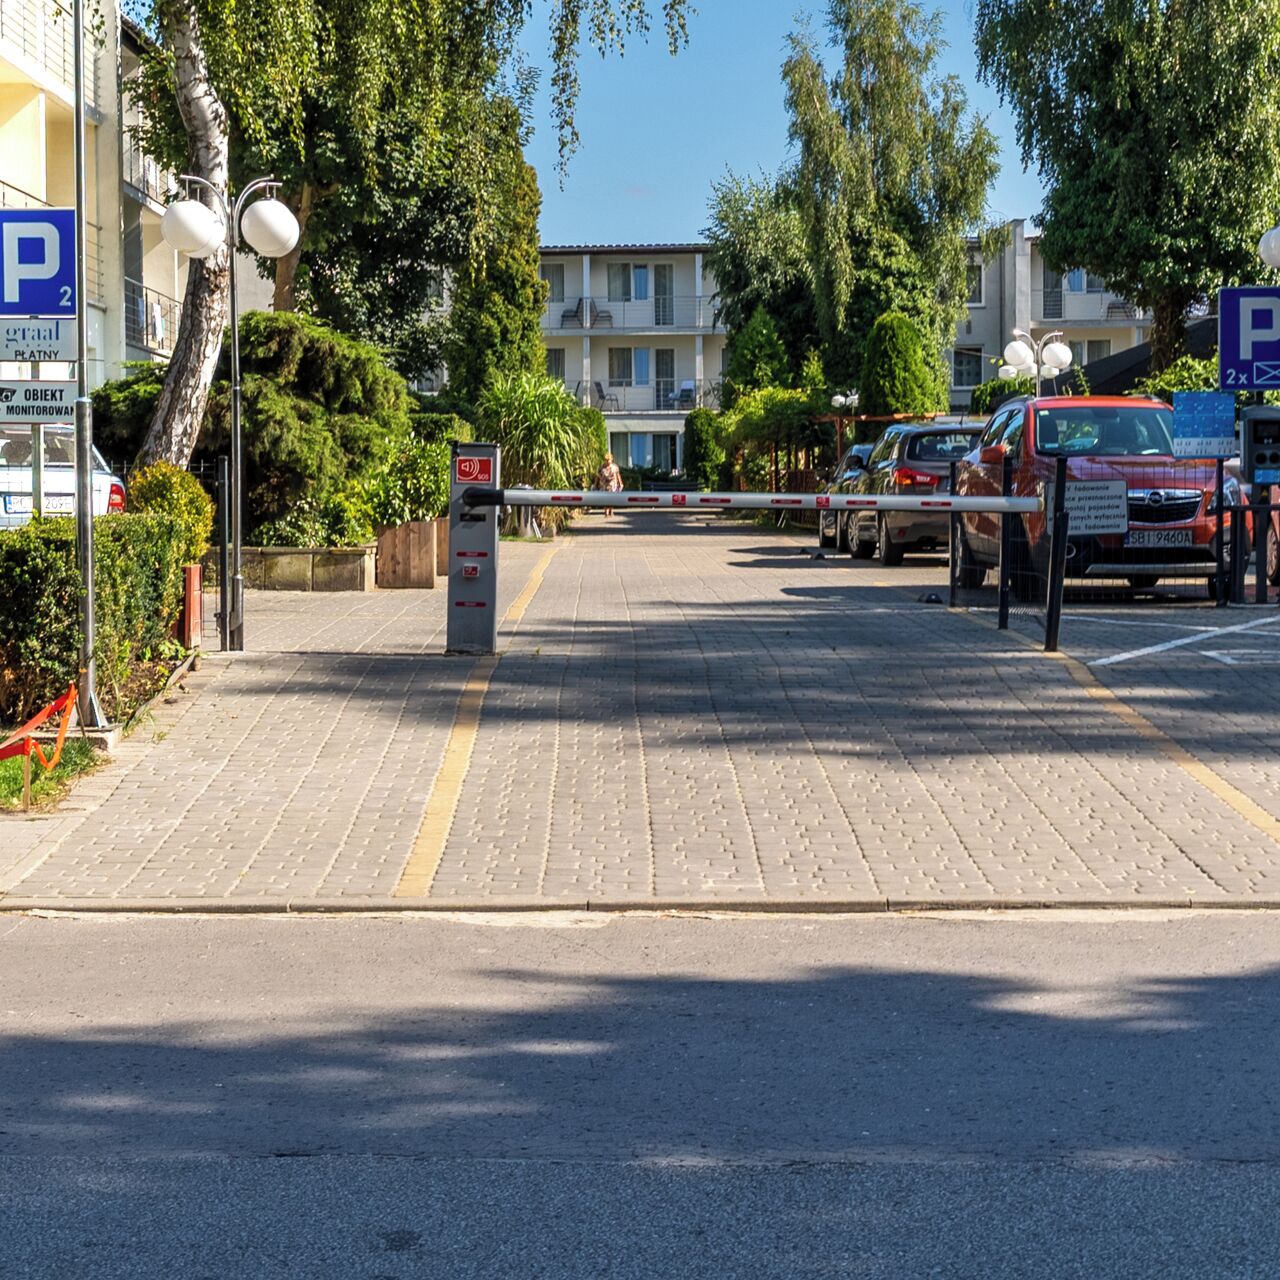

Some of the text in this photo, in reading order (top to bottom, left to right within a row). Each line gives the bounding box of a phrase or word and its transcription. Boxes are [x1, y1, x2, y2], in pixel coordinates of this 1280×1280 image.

[3, 222, 59, 302] P
[59, 285, 72, 306] 2
[5, 320, 59, 349] graal
[14, 350, 59, 360] PŁATNY
[24, 388, 64, 401] OBIEKT
[6, 405, 74, 416] MONITOROWAN
[1156, 531, 1191, 544] 9460A
